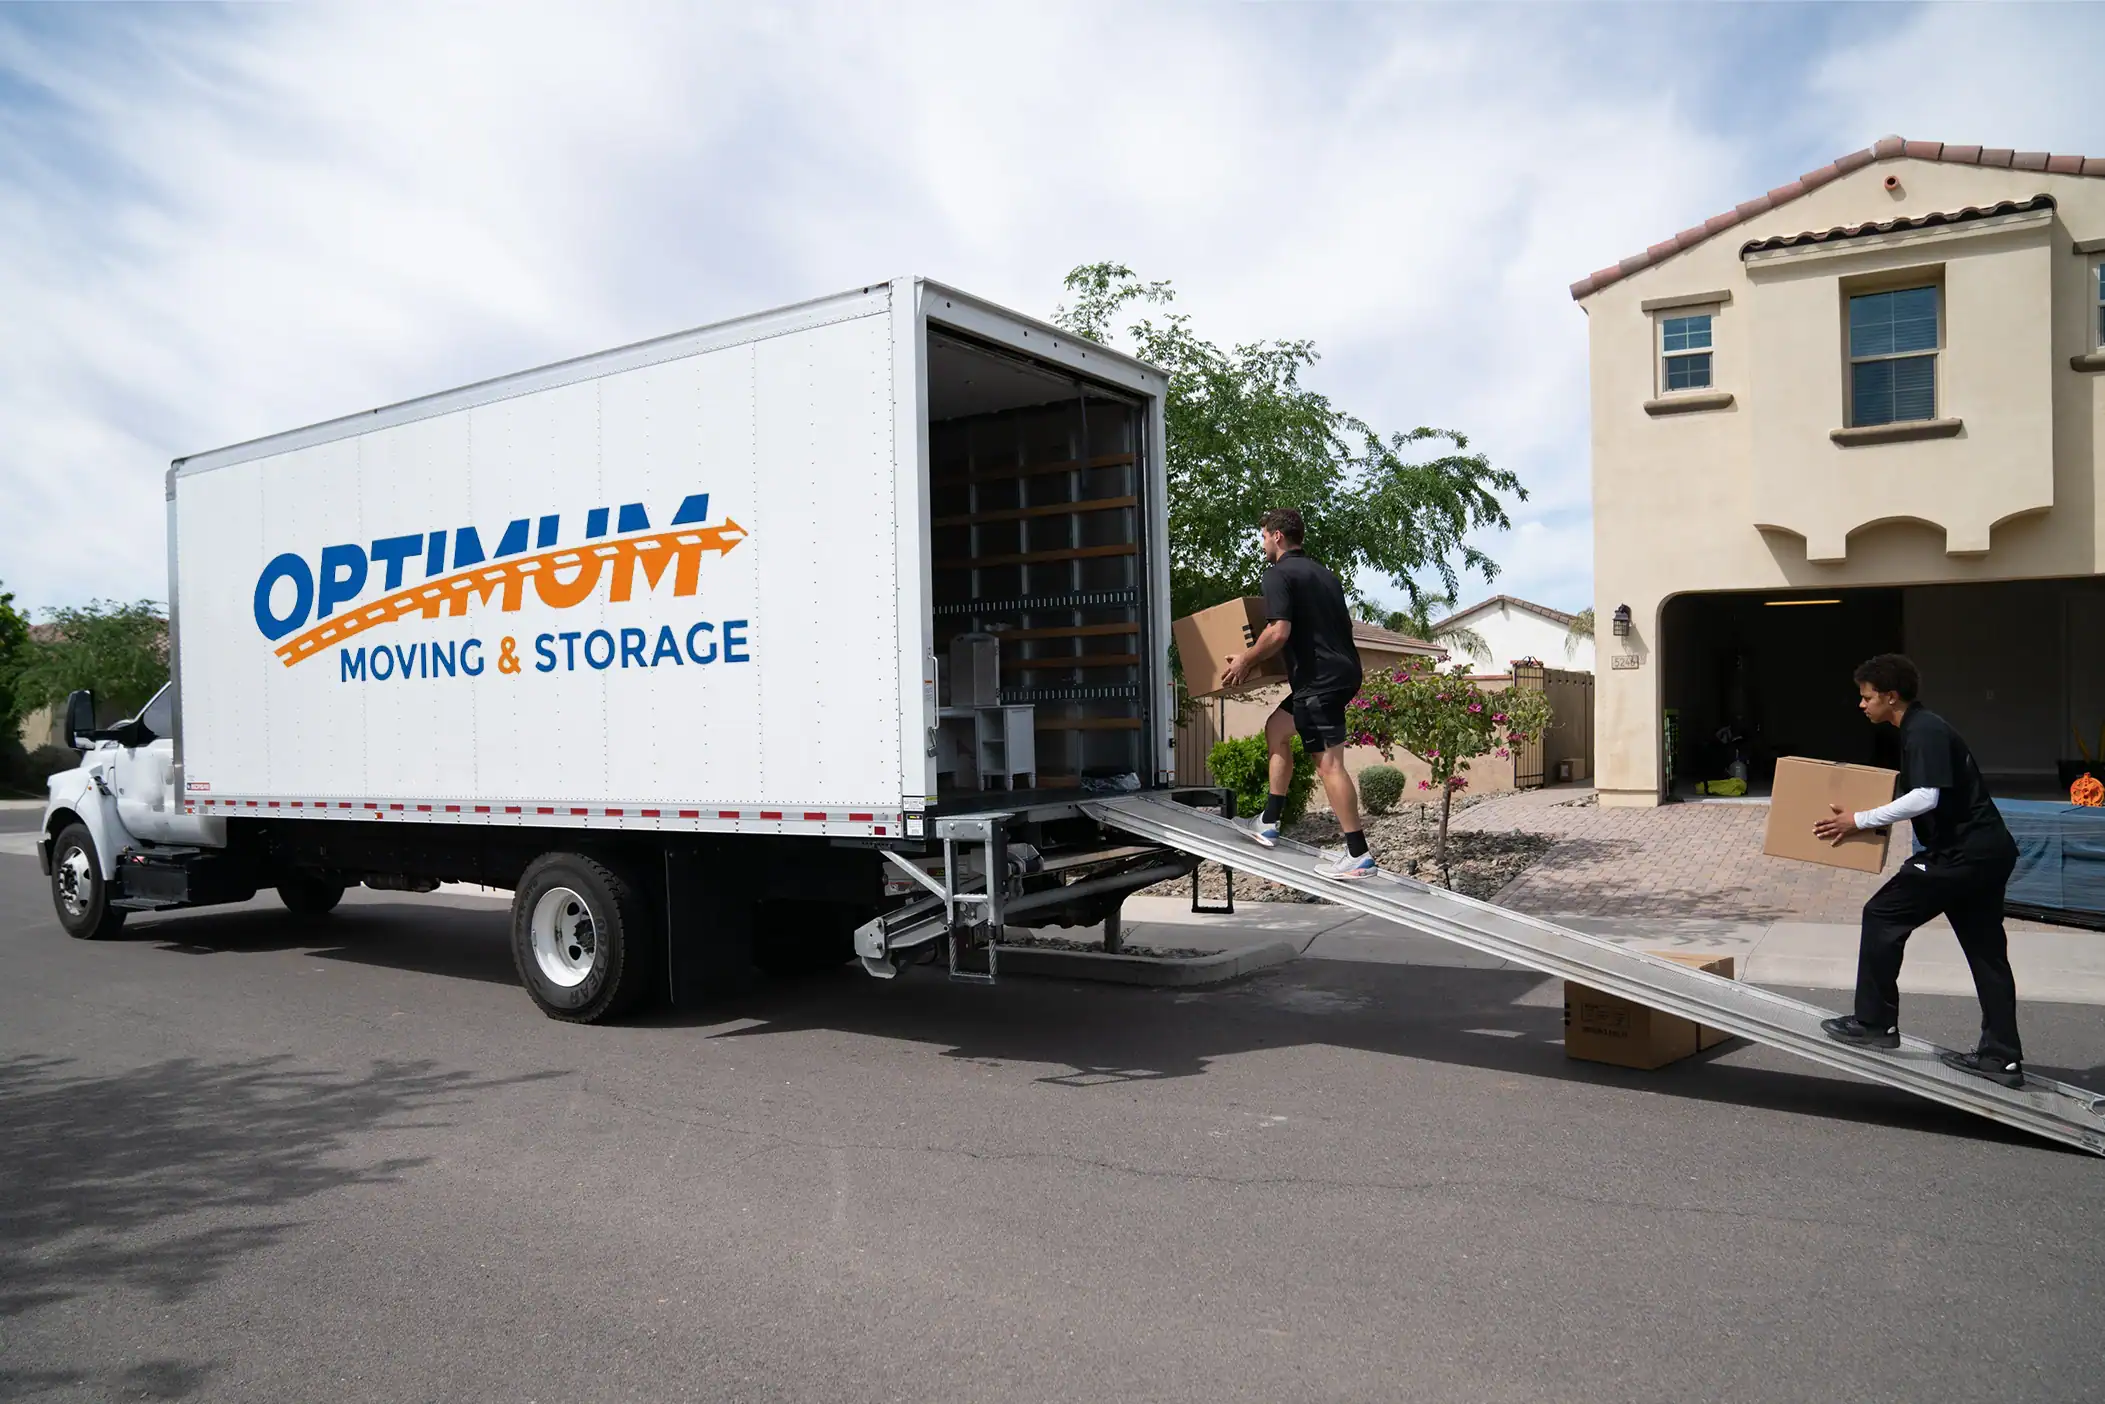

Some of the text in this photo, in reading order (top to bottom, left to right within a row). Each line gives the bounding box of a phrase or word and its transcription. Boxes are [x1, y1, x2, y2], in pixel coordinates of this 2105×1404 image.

[253, 493, 711, 641] OPTIMUM
[340, 619, 750, 683] MOVING & STORAGE
